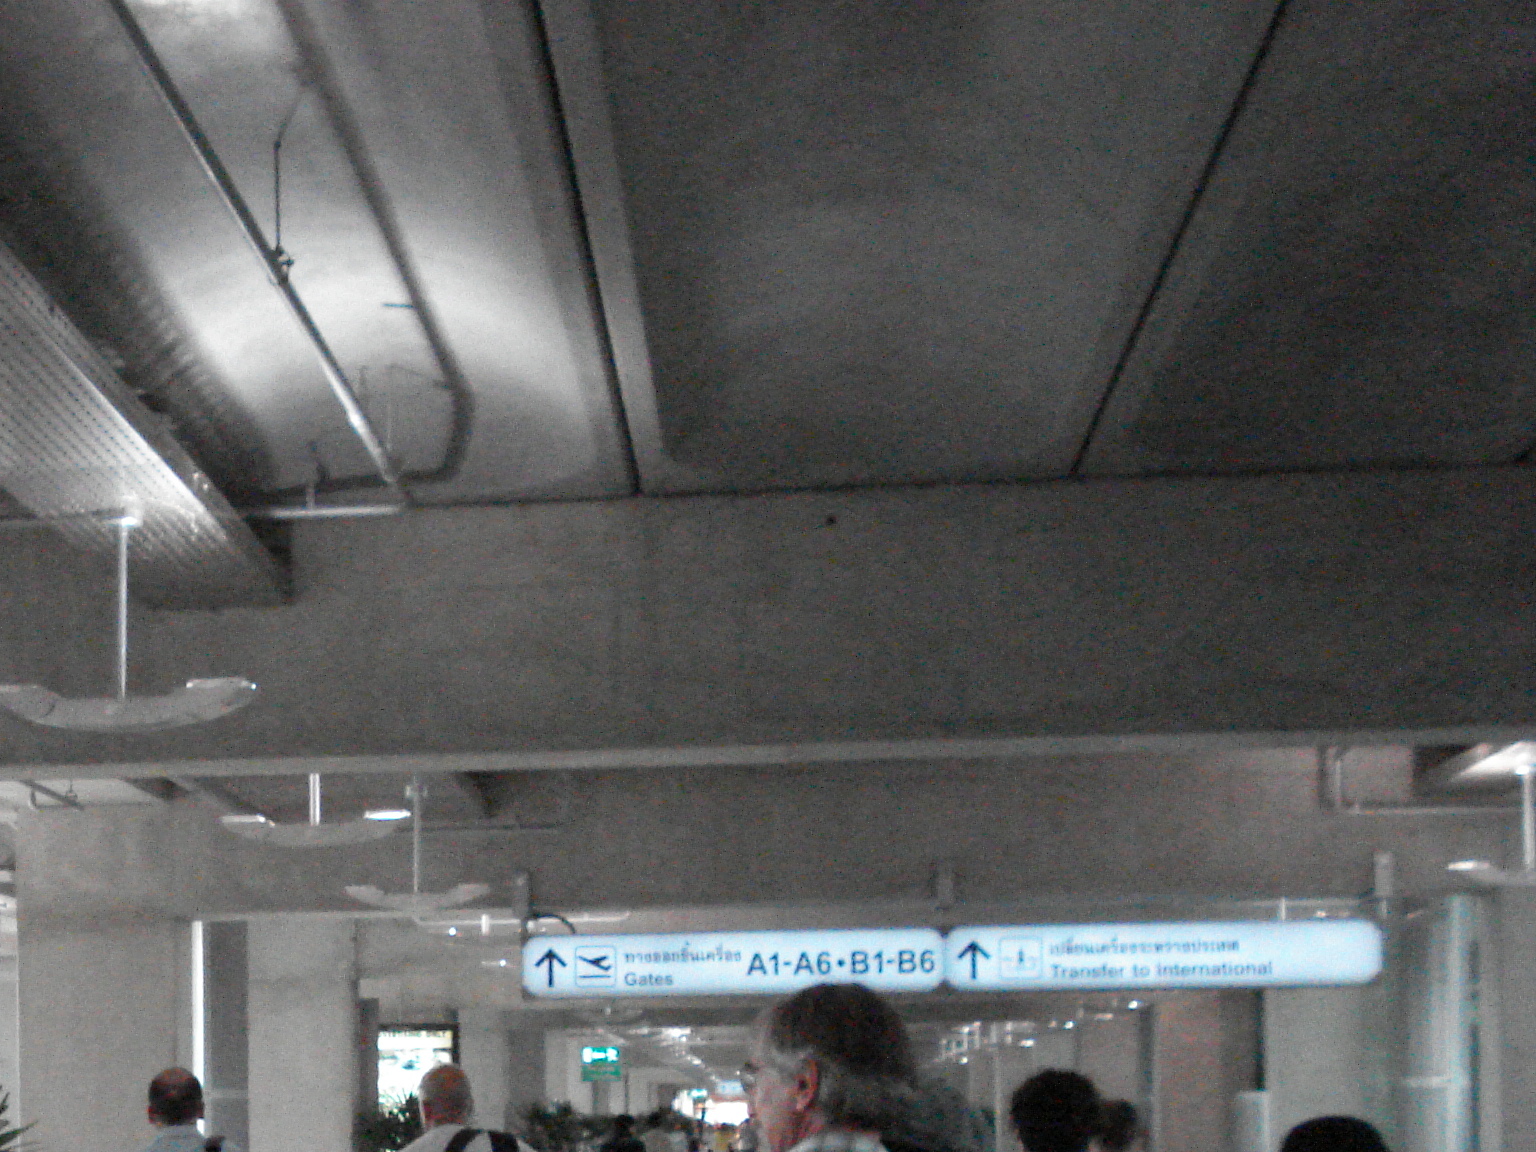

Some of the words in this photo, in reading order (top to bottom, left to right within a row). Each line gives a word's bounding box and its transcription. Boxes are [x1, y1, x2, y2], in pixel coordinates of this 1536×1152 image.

[1051, 964, 1124, 979] Transfer
[1132, 963, 1150, 978] to
[624, 972, 673, 986] Gates
